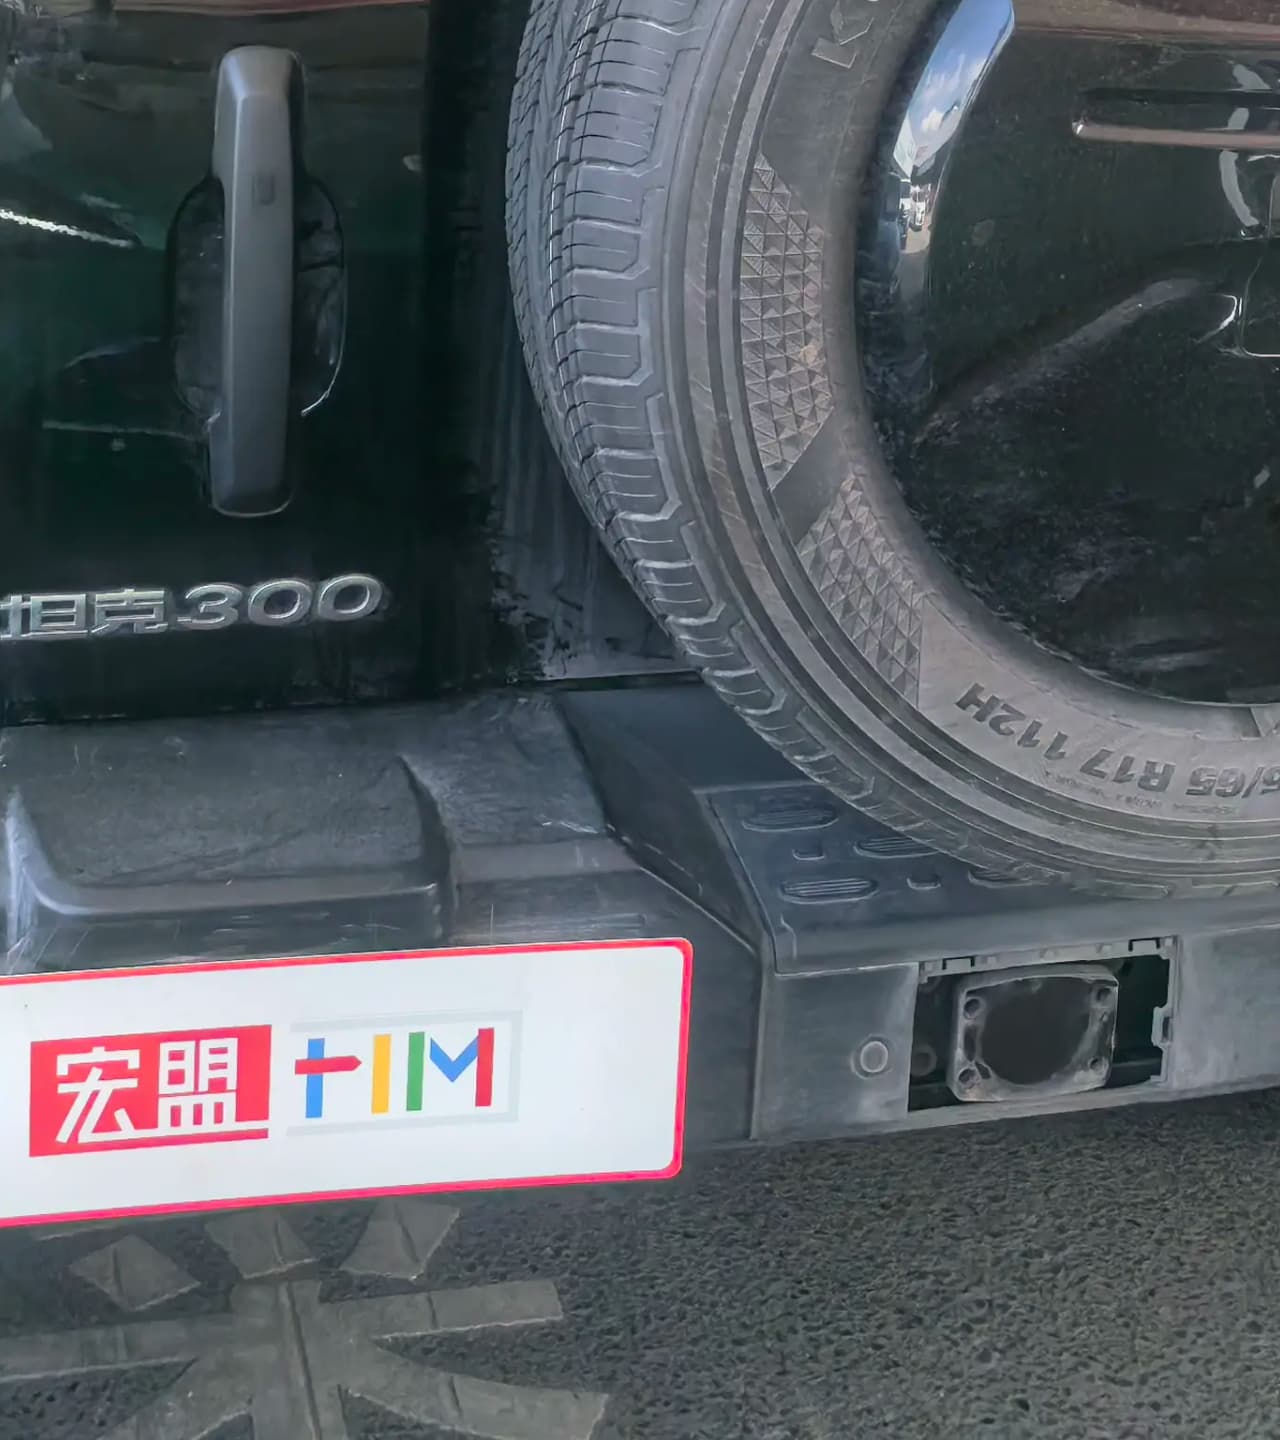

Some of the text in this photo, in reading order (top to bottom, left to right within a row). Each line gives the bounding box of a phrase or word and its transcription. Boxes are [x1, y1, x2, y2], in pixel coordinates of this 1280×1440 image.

[955, 681, 1069, 762] 112H
[1080, 747, 1177, 794] R17
[55, 1036, 240, 1146] 宏盟
